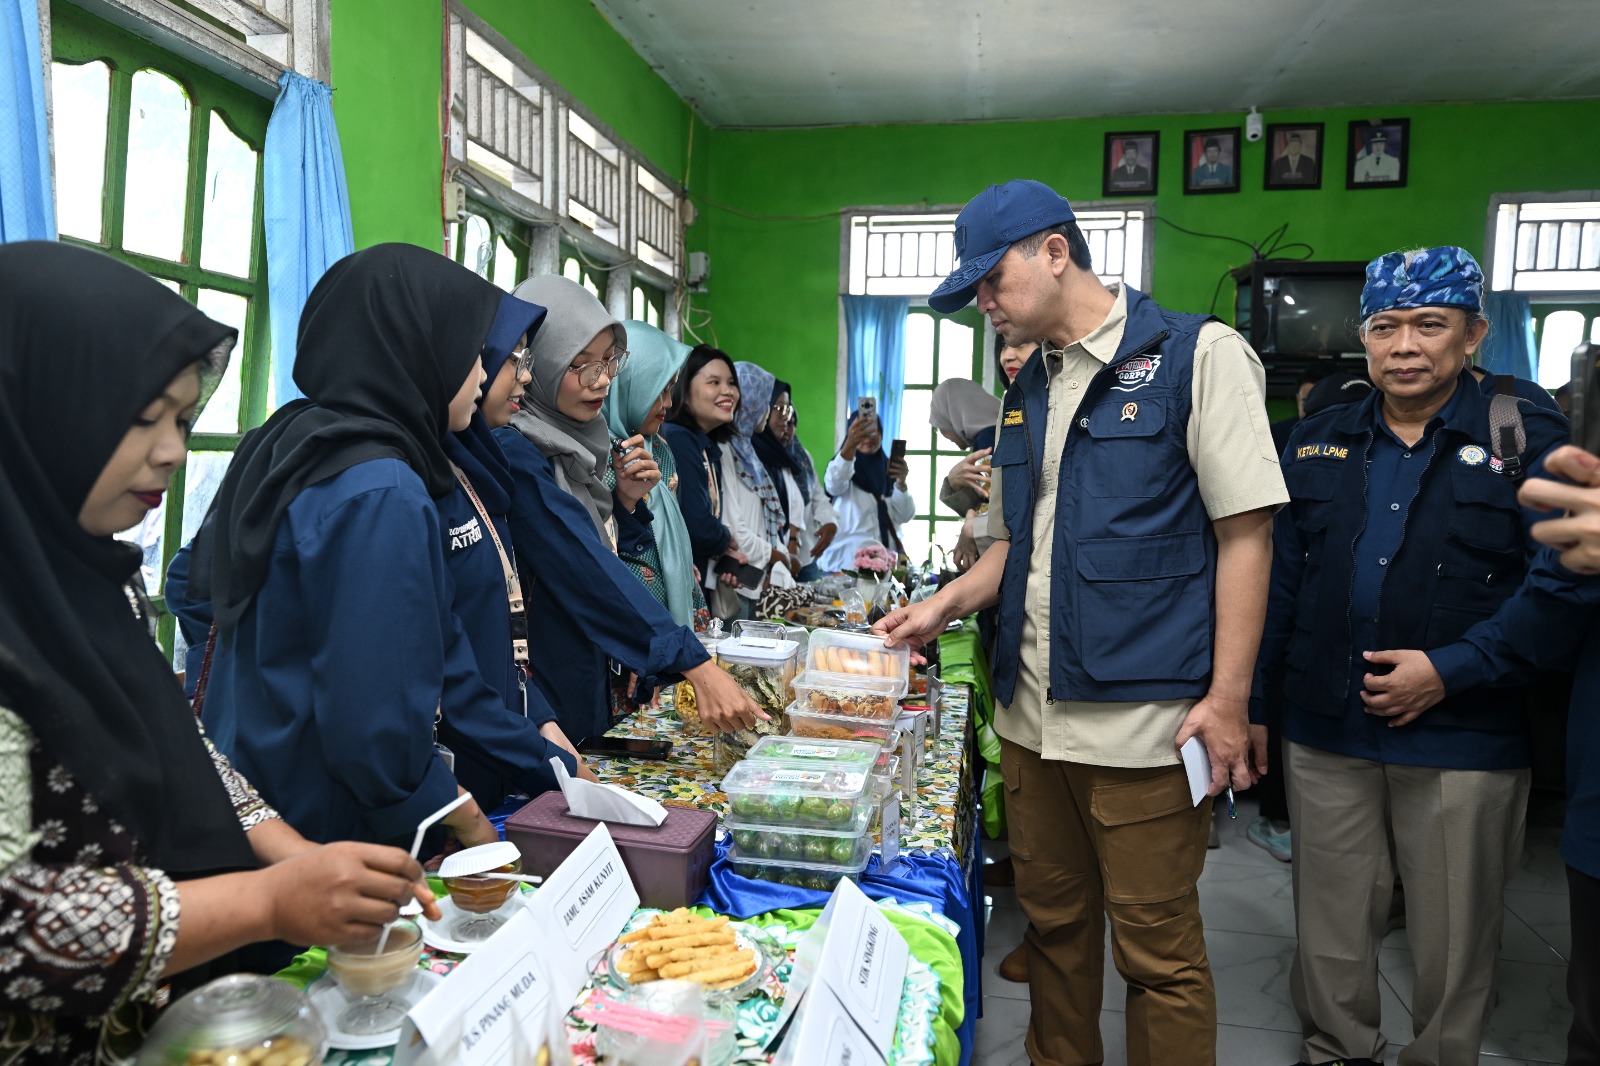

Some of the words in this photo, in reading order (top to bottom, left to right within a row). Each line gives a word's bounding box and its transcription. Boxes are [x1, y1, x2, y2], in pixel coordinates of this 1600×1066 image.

[1118, 370, 1147, 380] CORPS
[1297, 445, 1320, 459] KETUA
[563, 902, 581, 927] JAMU
[578, 883, 596, 909] ASAM
[592, 861, 614, 891] KUNYIT
[509, 971, 537, 999] MUDA
